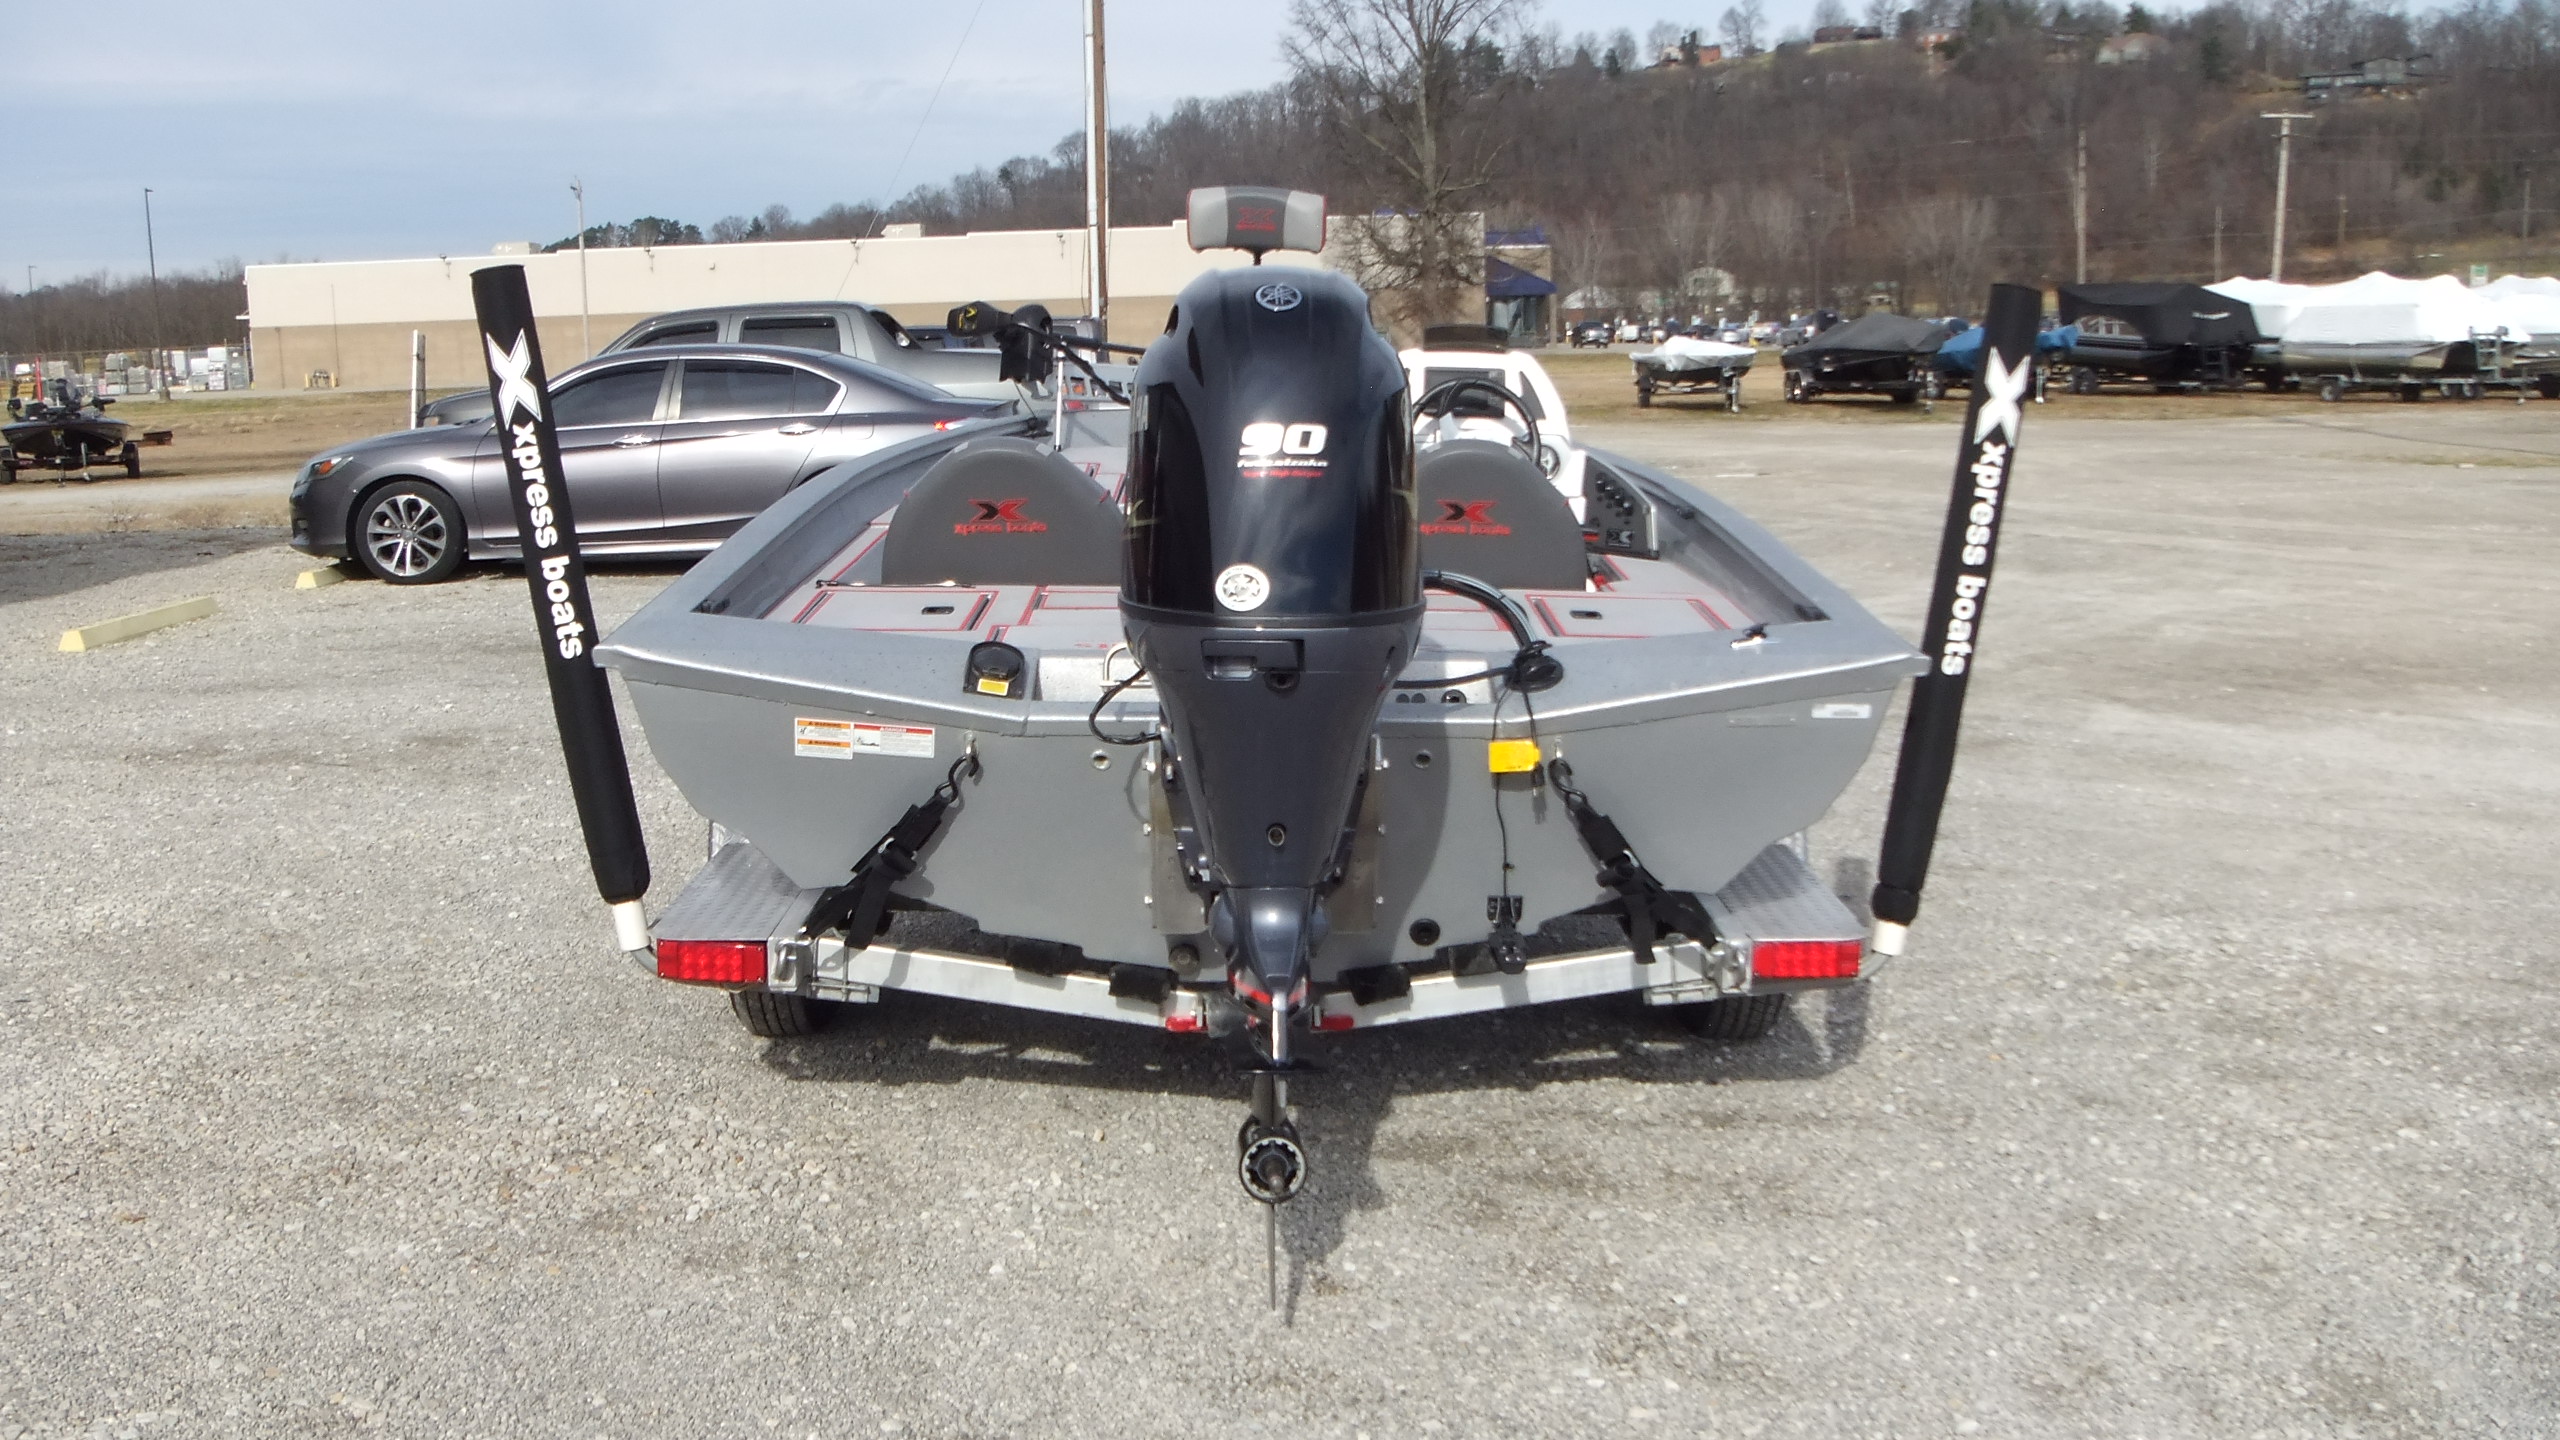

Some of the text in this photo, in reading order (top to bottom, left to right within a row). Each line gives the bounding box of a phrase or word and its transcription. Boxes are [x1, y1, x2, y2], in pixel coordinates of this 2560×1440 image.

[1239, 423, 1328, 456] 90
[512, 421, 558, 549] xpress
[541, 555, 585, 660] boats
[1962, 441, 2007, 566] xpress
[1941, 574, 1987, 676] boats
